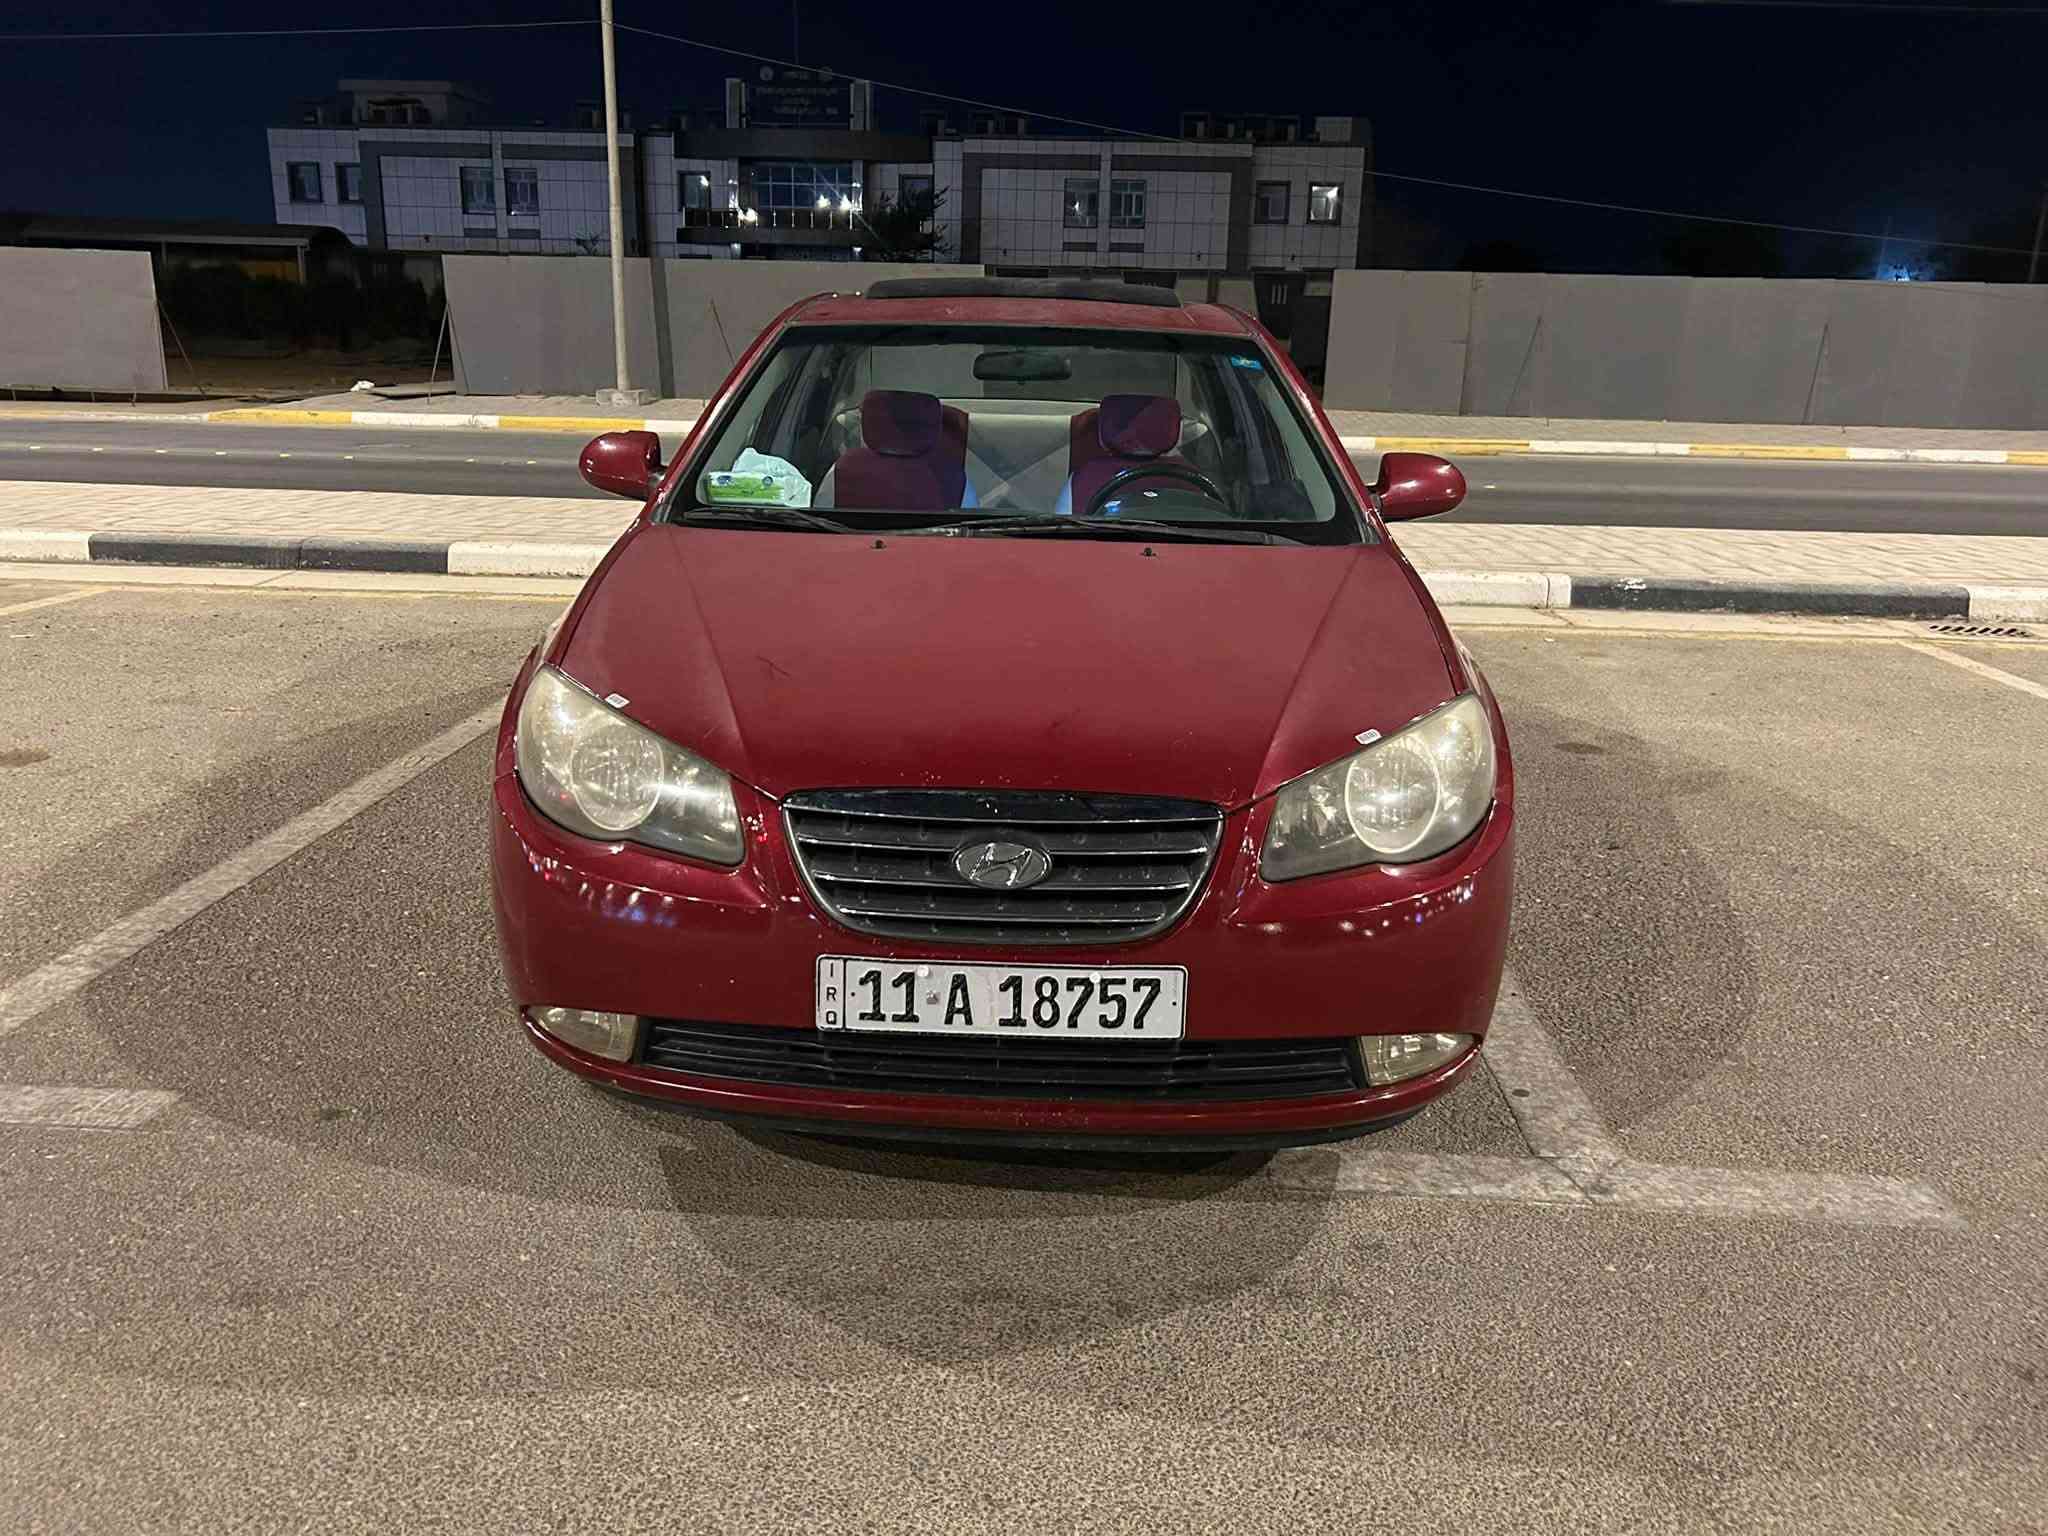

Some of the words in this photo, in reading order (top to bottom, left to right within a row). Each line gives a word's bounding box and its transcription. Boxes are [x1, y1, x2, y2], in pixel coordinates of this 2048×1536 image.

[826, 963, 837, 1024] IRQ
[859, 970, 920, 1023] 11
[944, 973, 973, 1026] A
[999, 975, 1161, 1029] 18757
